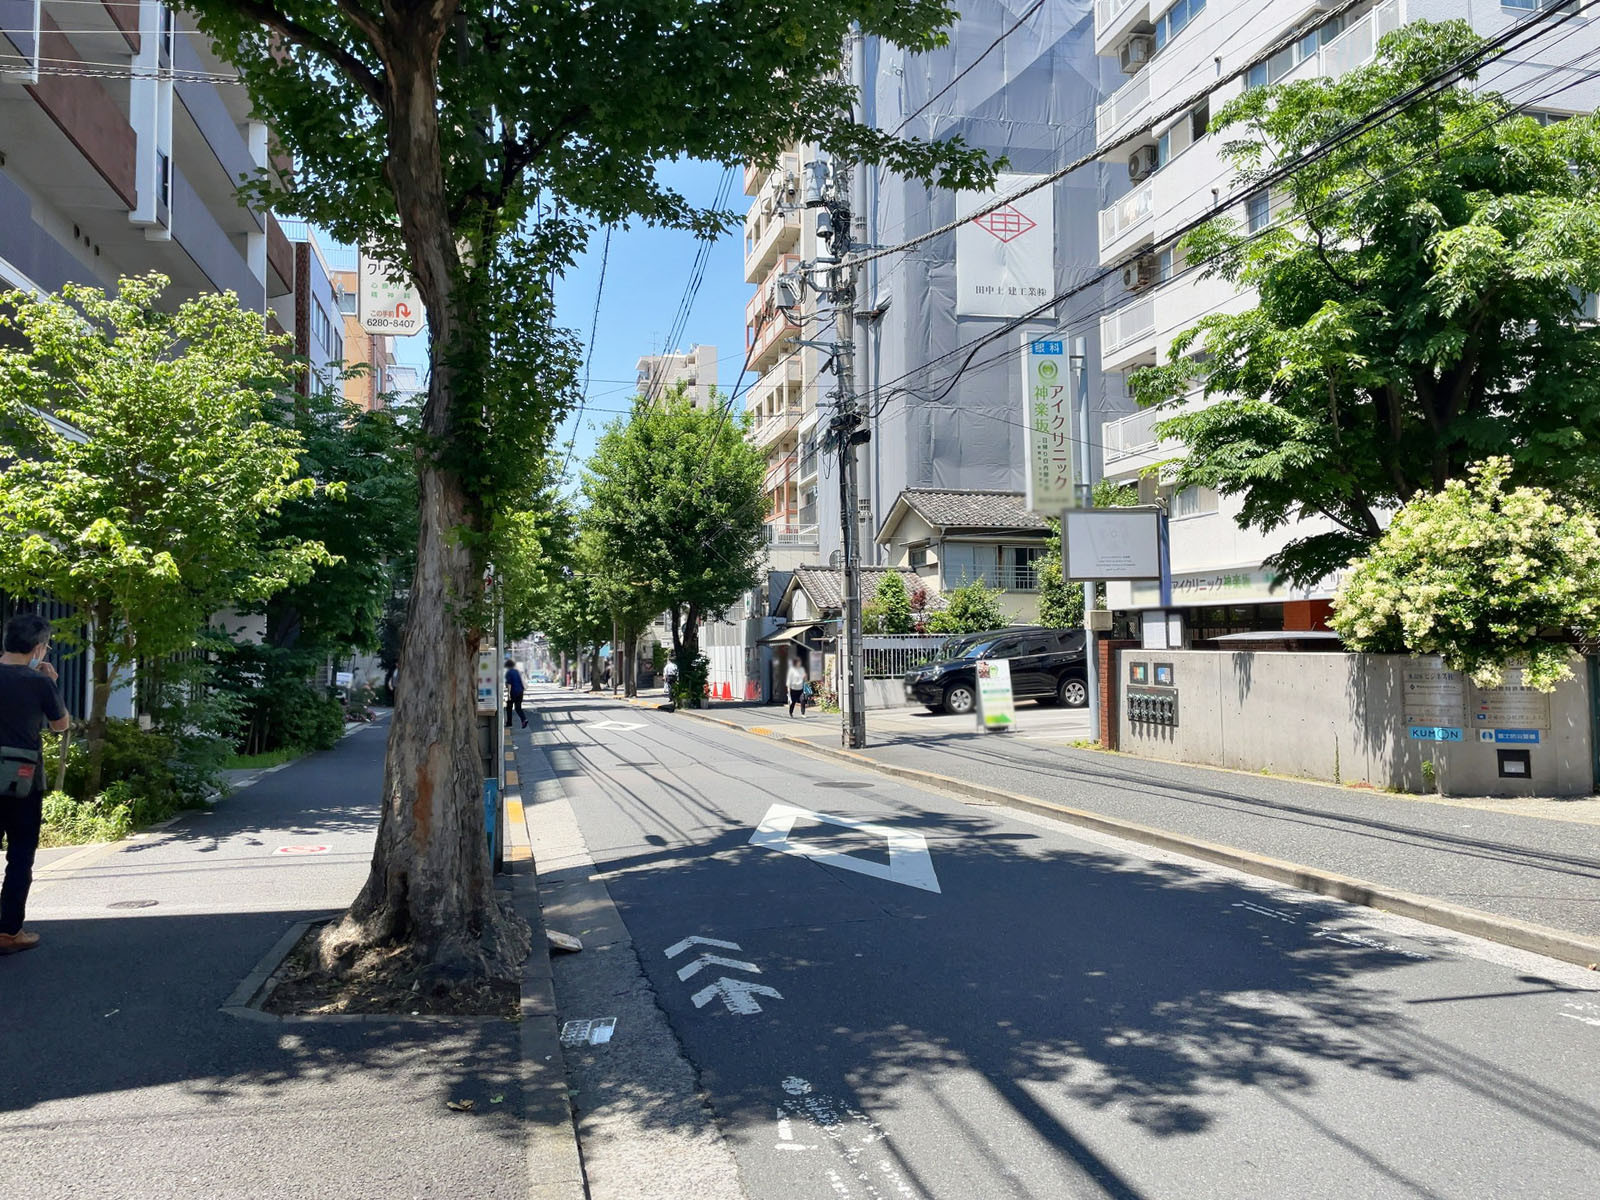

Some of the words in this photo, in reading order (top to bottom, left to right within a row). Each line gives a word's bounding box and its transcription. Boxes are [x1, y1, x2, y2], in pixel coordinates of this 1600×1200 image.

[367, 318, 415, 328] 6280-8407
[1035, 343, 1060, 353] 眼科
[1034, 385, 1049, 433] 神楽坂
[1050, 385, 1067, 490] アイクリニック
[1412, 729, 1459, 740] KUMON
